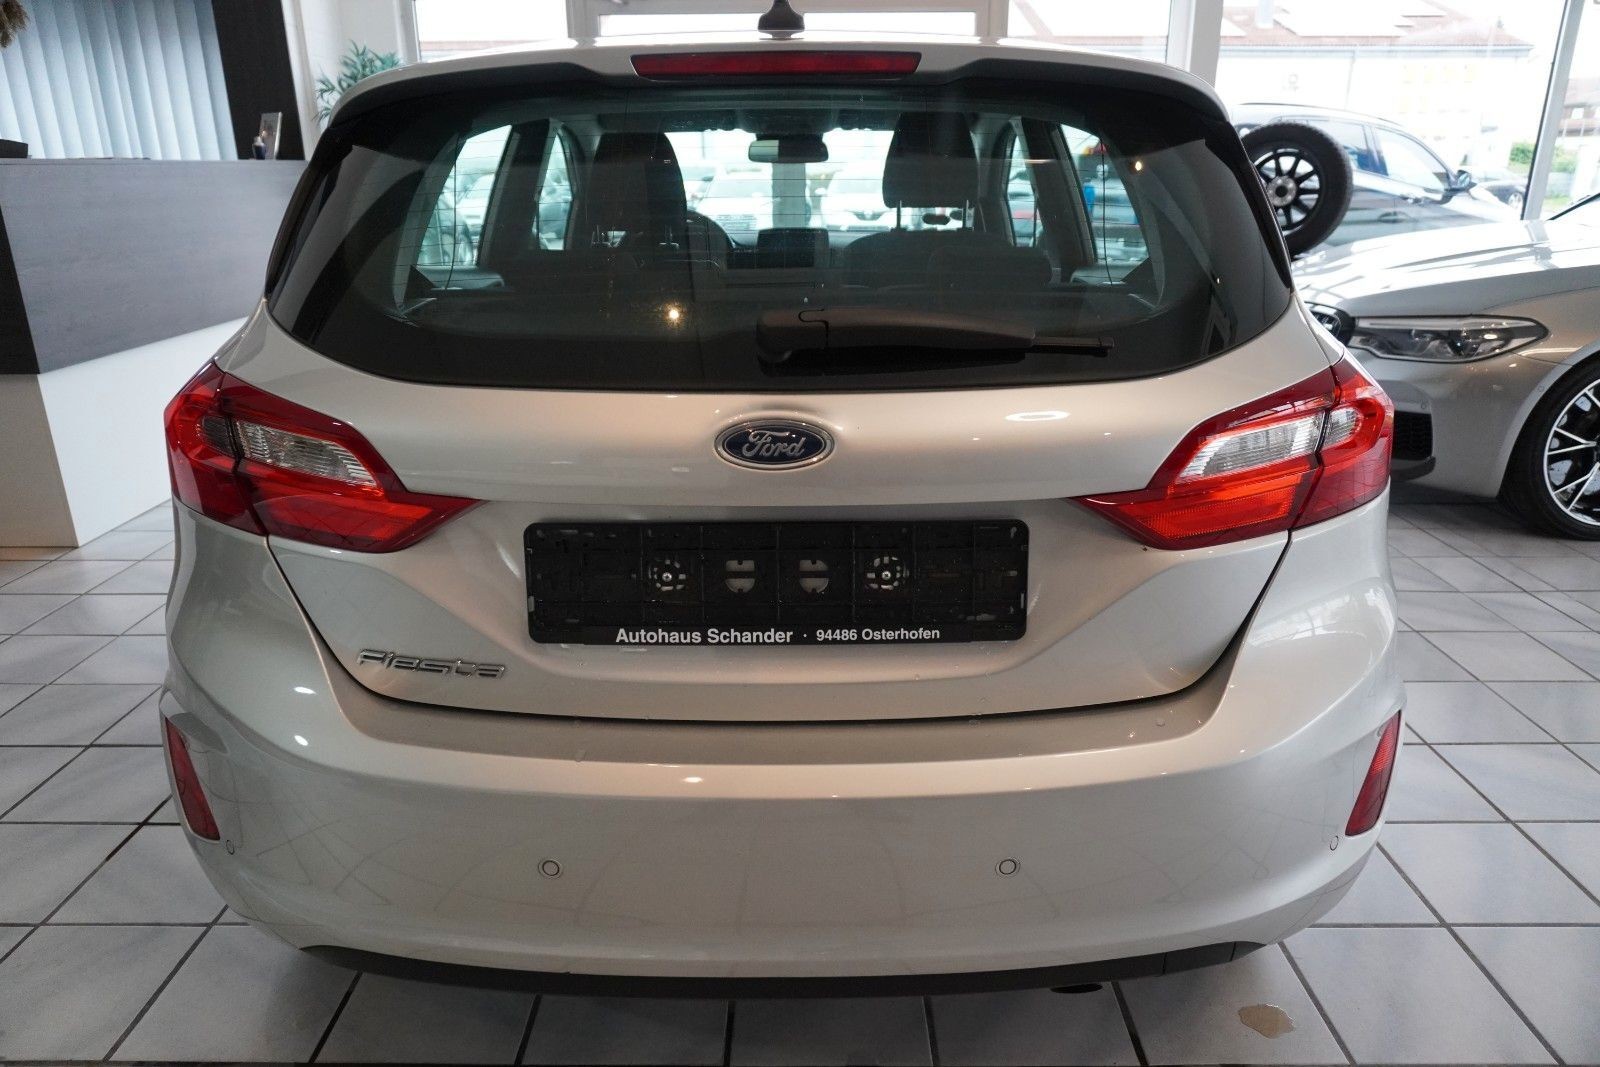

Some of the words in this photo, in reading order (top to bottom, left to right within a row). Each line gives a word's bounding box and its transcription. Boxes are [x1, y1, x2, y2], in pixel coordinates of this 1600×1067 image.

[741, 429, 807, 457] Ford
[615, 627, 702, 644] Autohaus
[706, 627, 794, 645] Schander
[815, 629, 858, 642] 94486
[861, 627, 941, 641] Osterhofen
[357, 649, 505, 680] Fiesta
